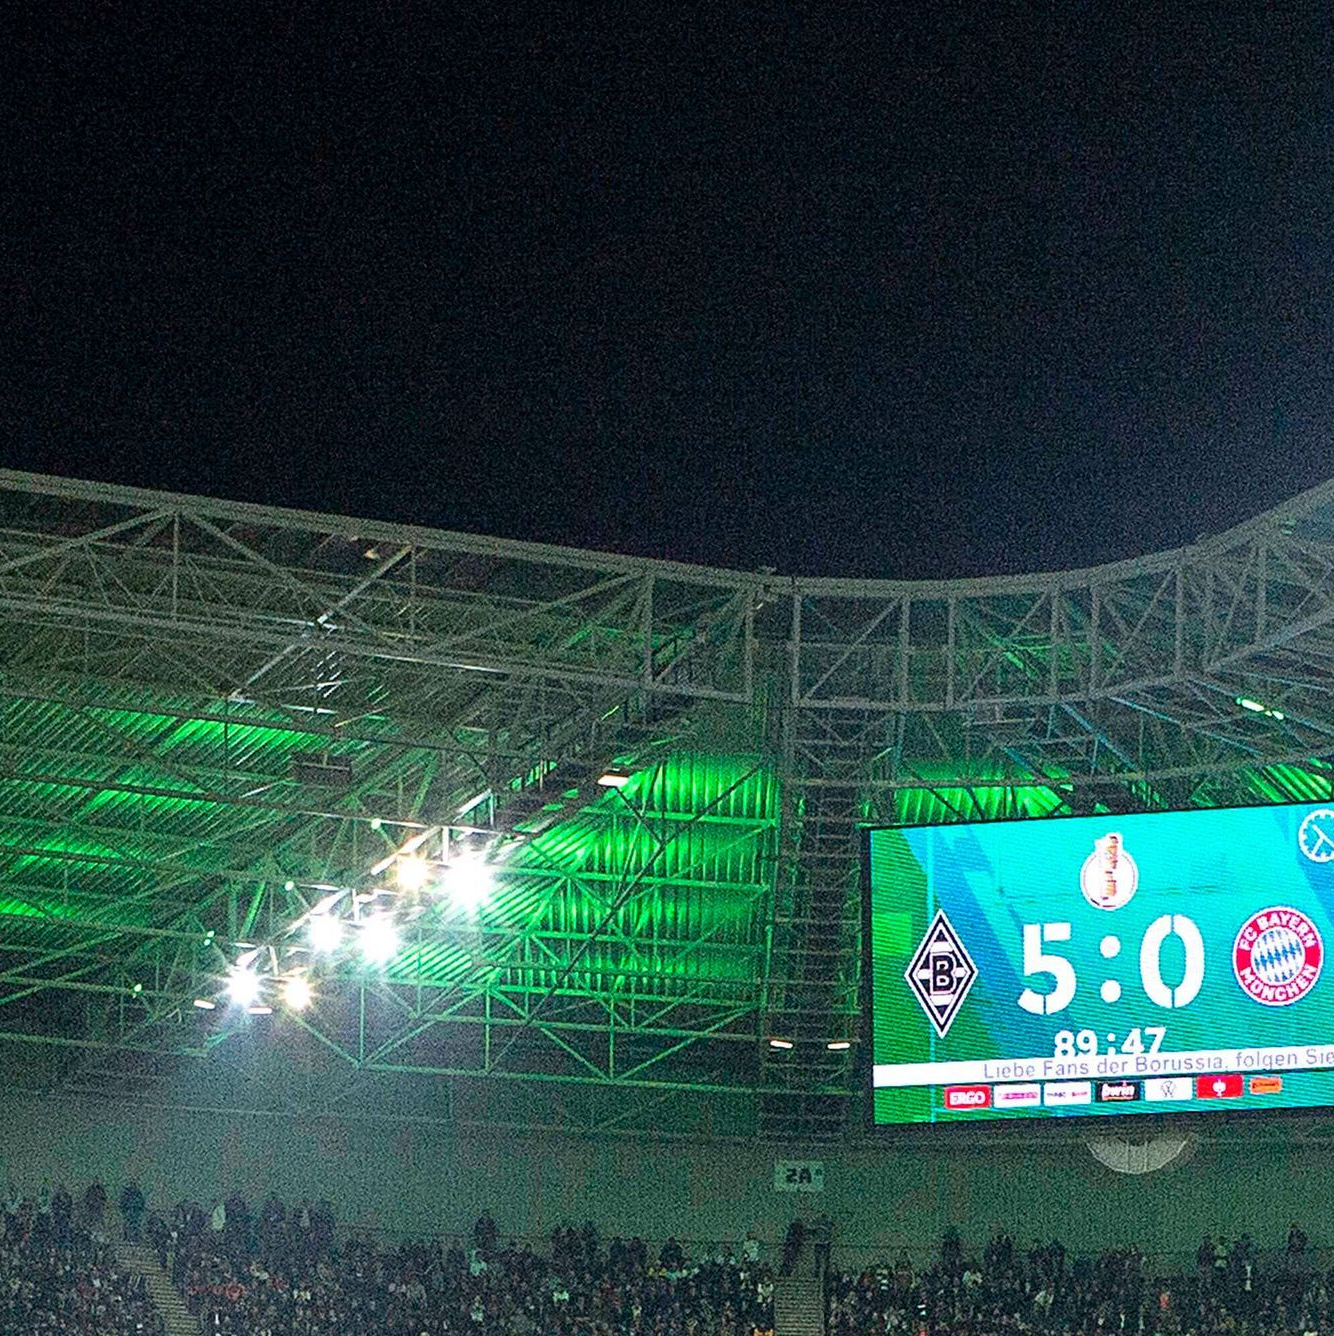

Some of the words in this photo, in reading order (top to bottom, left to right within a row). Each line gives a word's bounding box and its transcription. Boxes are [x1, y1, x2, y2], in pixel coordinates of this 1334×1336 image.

[1255, 911, 1318, 948] BAYERN
[1054, 1026, 1167, 1058] 89:47
[983, 1062, 1036, 1080] Liebe
[1043, 1060, 1090, 1077] Fans
[1096, 1058, 1129, 1075] der
[1236, 1050, 1298, 1069] folgen
